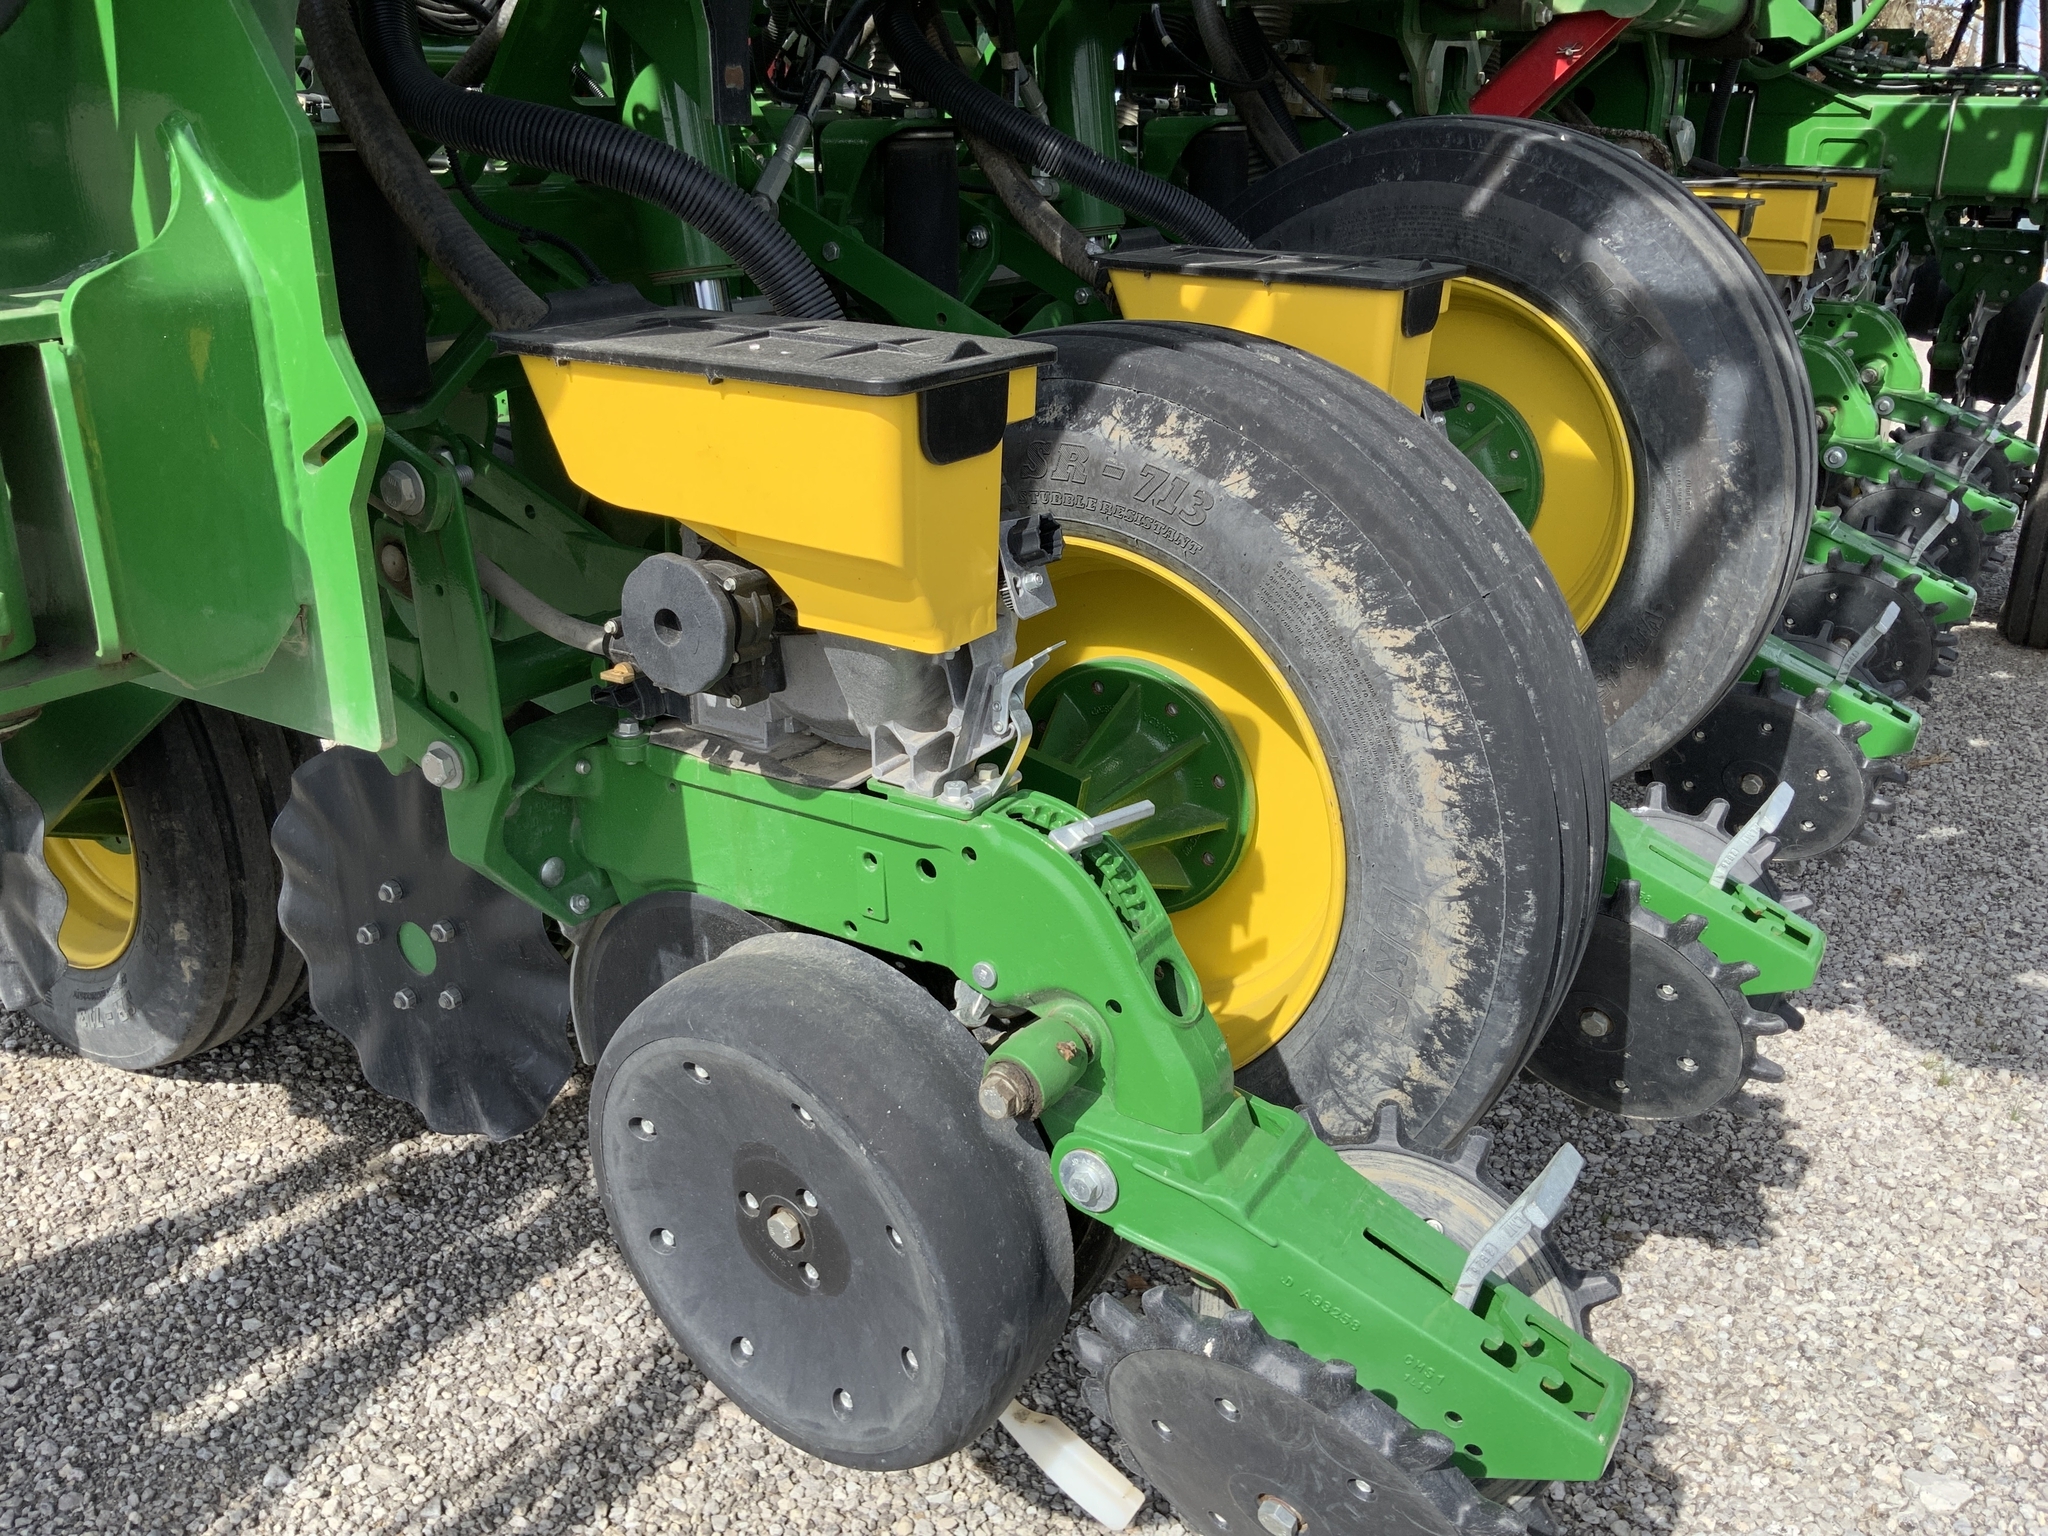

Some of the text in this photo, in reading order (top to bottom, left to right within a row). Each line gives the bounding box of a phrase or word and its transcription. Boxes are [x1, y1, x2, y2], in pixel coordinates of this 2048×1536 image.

[1020, 440, 1090, 484] SR
[1132, 463, 1215, 527] 713
[1019, 490, 1203, 555] STUBBLE RESISTANT
[1275, 559, 1306, 591] SAFETY
[1300, 1288, 1361, 1332] A93258
